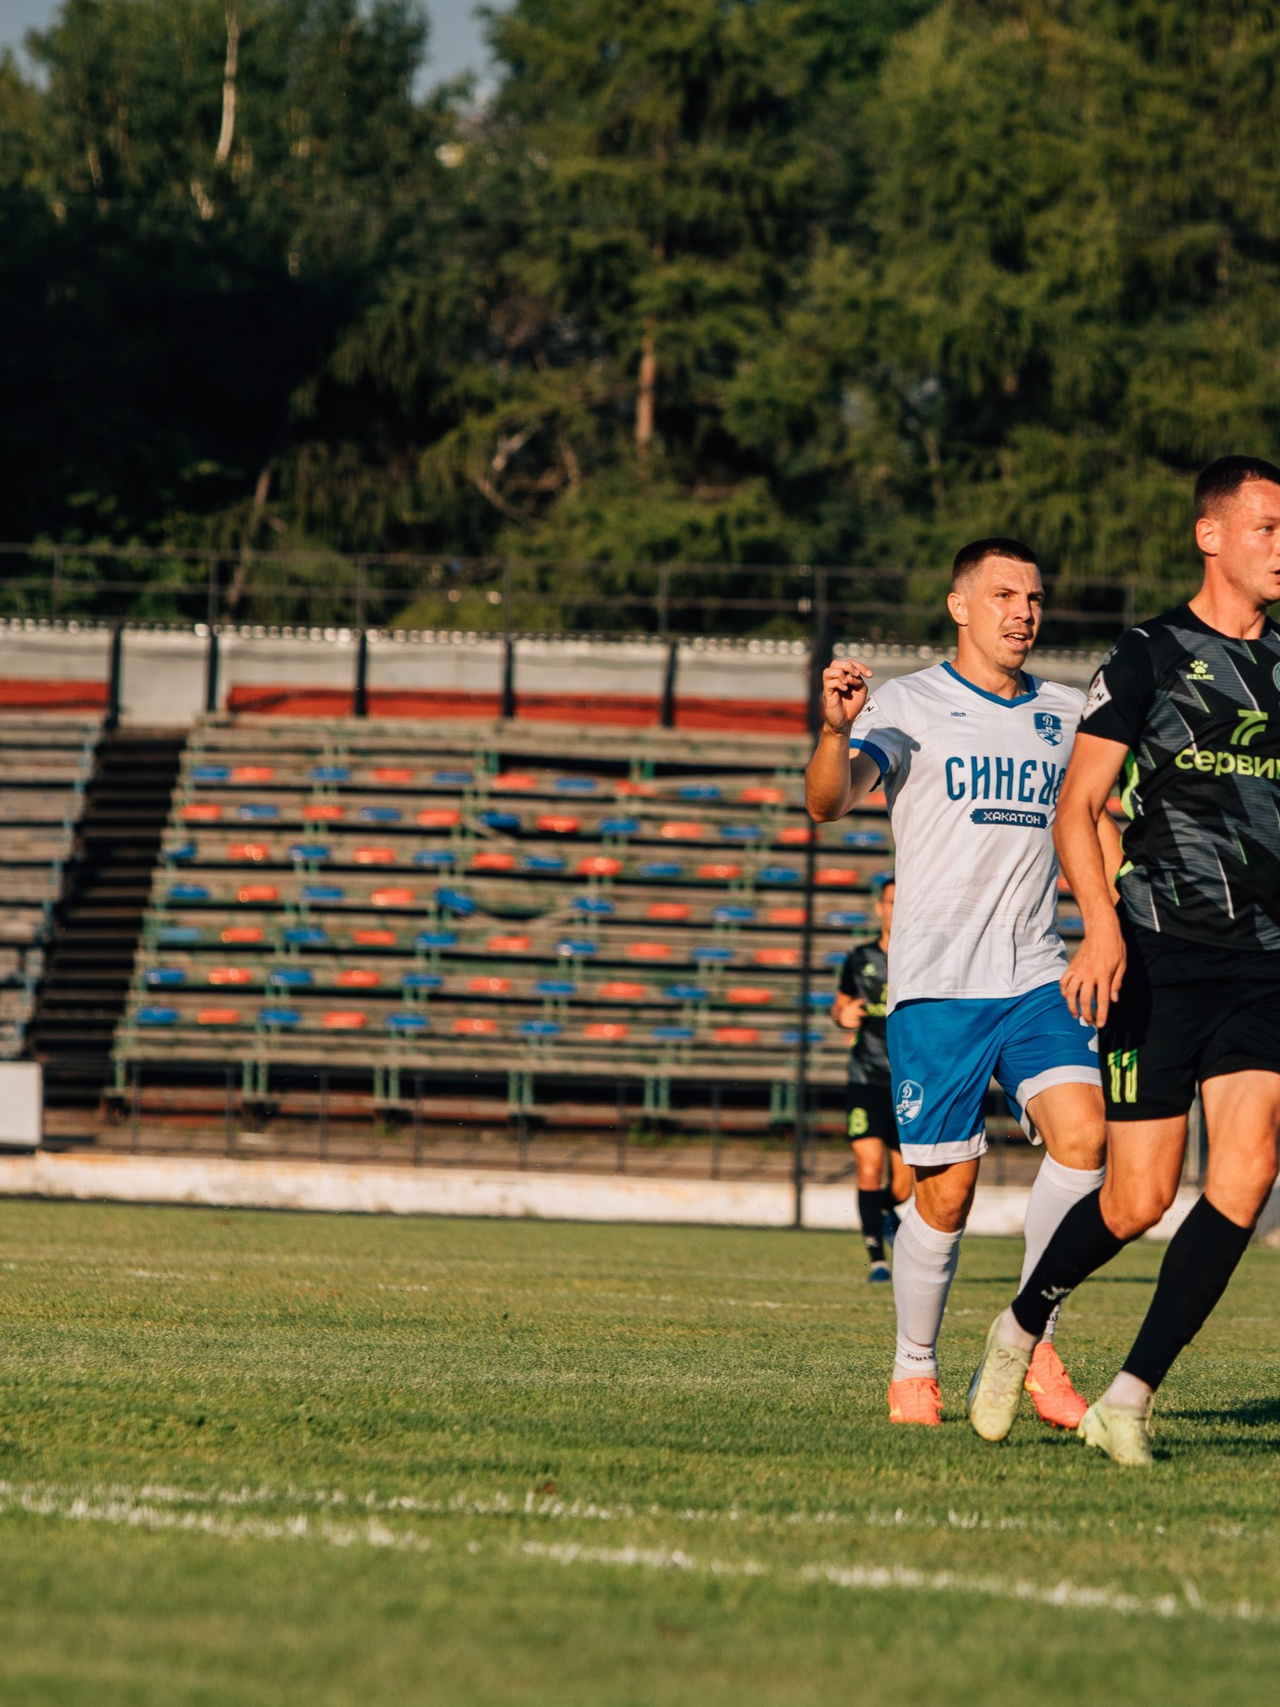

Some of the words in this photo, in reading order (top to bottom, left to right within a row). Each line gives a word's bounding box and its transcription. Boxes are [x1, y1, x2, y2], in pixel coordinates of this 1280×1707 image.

[1186, 673, 1215, 681] KELME
[983, 811, 1041, 825] ХАКАТОН
[1107, 1049, 1138, 1103] 11
